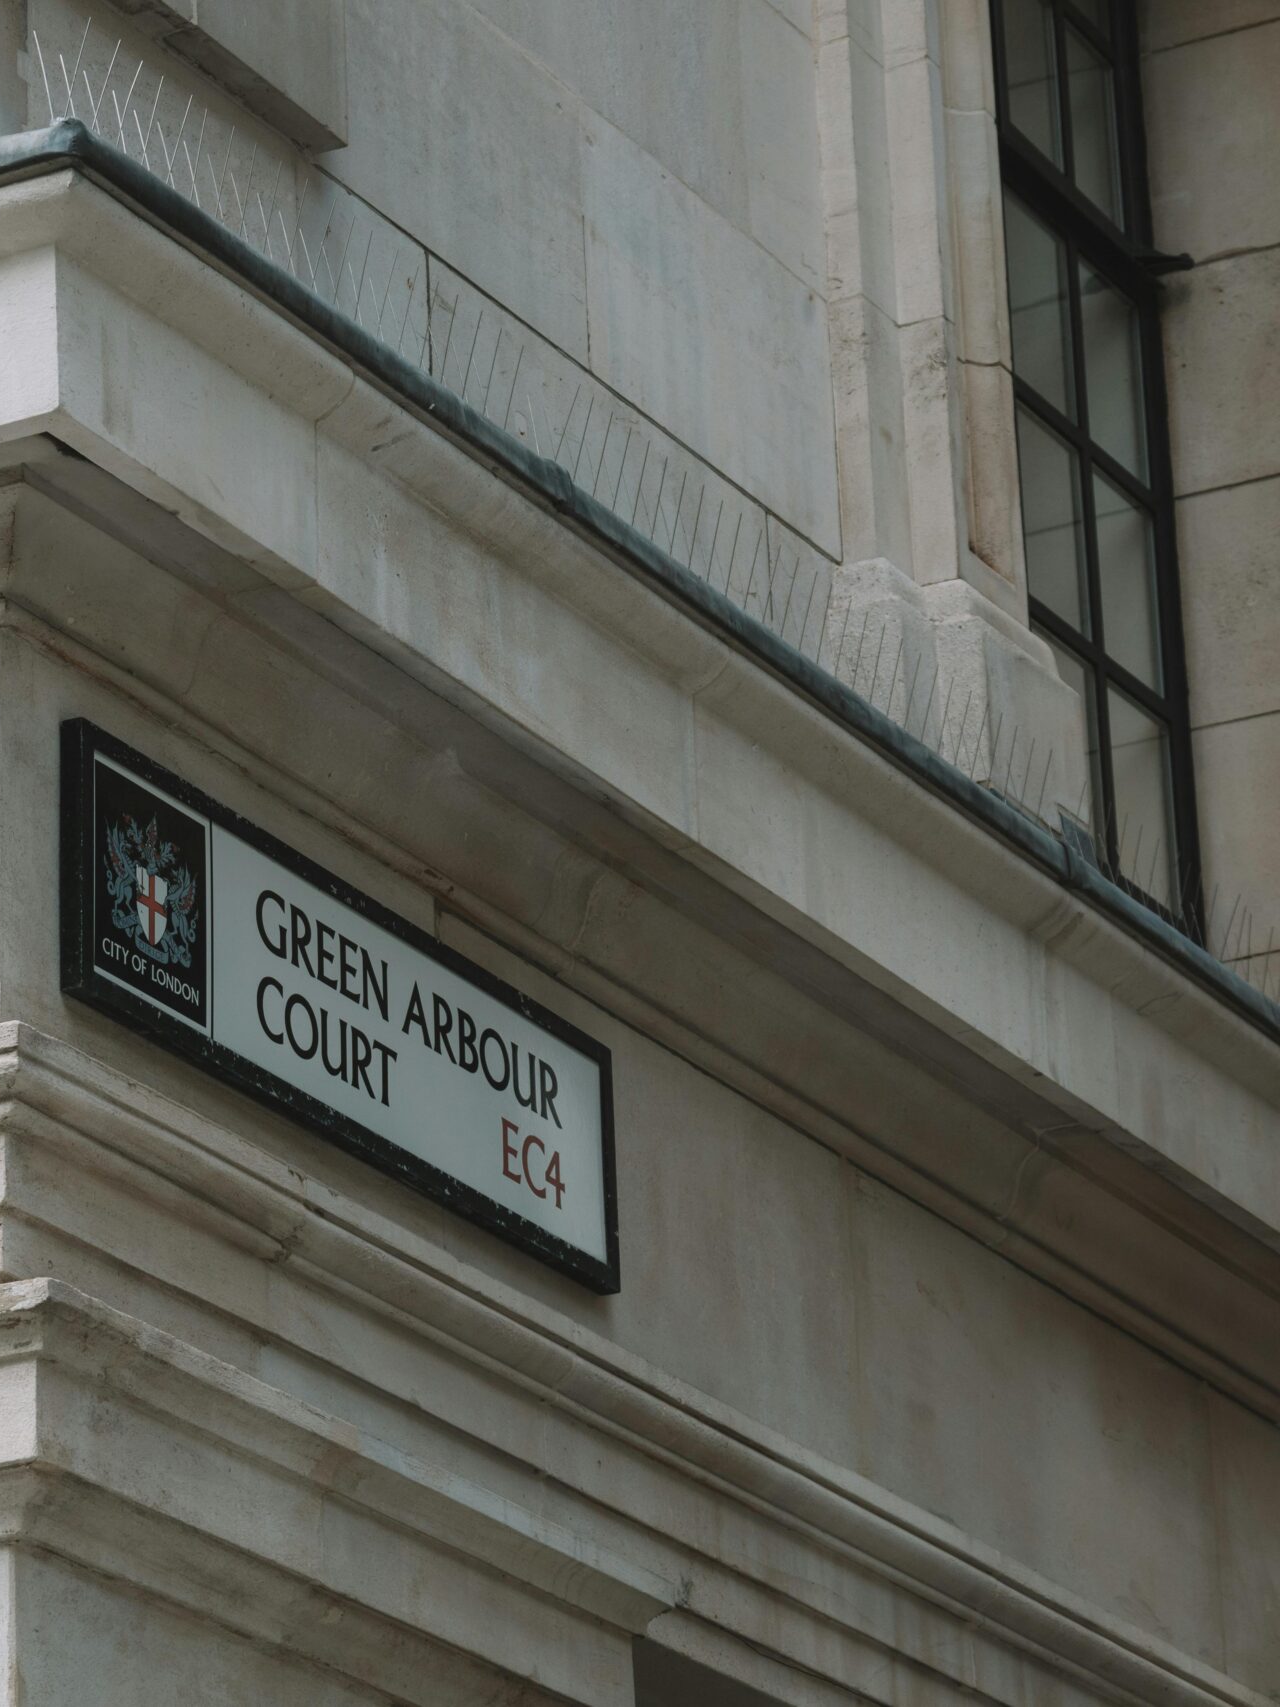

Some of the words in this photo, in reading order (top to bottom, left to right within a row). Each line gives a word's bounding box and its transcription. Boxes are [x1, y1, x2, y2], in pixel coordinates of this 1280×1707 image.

[102, 937, 129, 965] CITY
[131, 954, 147, 976] OF
[151, 964, 200, 1007] LONDON
[256, 889, 389, 1022] GREEN
[402, 981, 563, 1129] ARBOUR
[256, 976, 398, 1107] COURT
[501, 1117, 566, 1209] EC4
